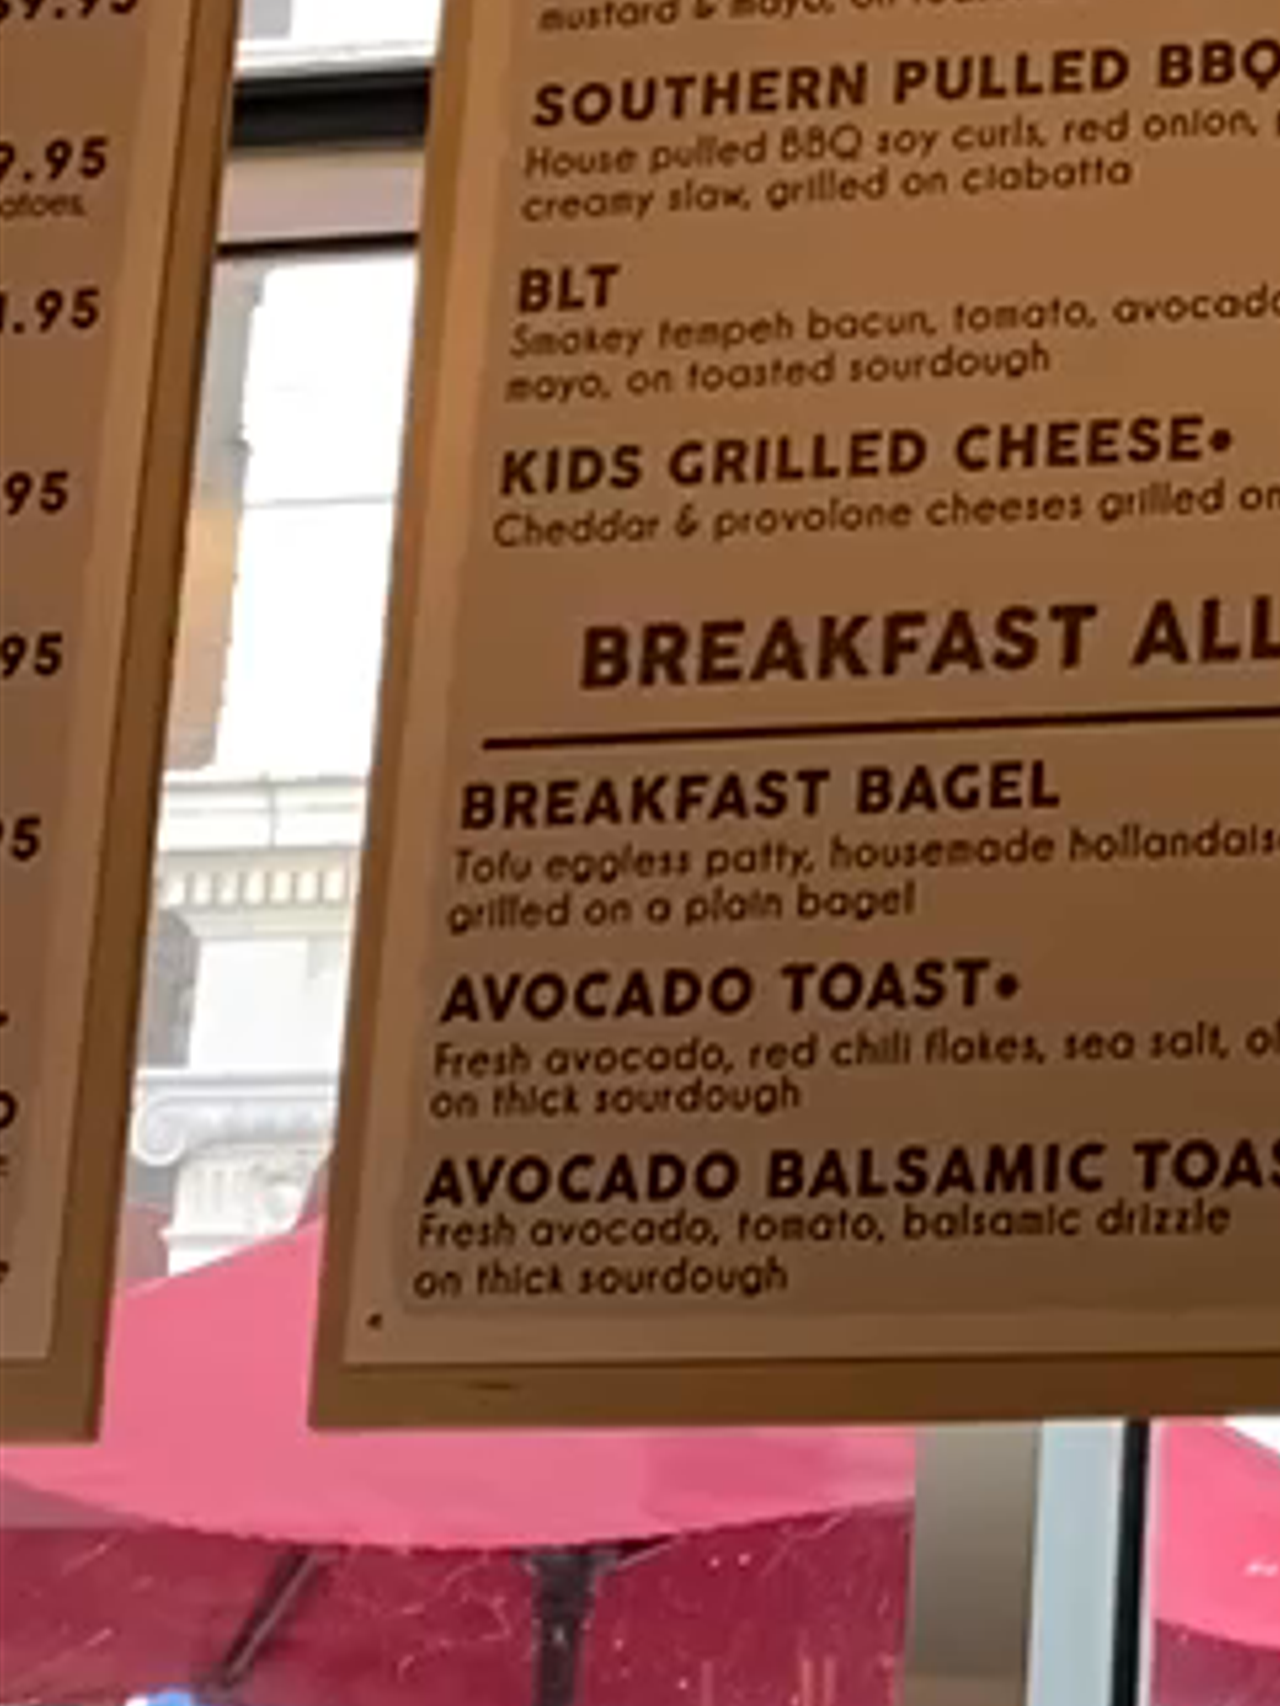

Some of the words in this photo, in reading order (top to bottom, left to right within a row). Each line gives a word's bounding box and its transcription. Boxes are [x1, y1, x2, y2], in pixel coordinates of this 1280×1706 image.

[530, 59, 870, 130] SOUTHERN
[891, 44, 1132, 107] PULLED
[519, 189, 657, 224] creamy
[764, 163, 890, 212] grilled
[898, 169, 950, 199] on
[960, 154, 1135, 197] ciabatta
[0, 287, 99, 334] .95
[514, 261, 623, 317] BLT
[624, 367, 674, 398] on
[686, 349, 838, 394] toasted
[847, 337, 1052, 384] sourdough
[497, 442, 645, 499] KIDS
[665, 426, 929, 490] GRILLED
[491, 507, 662, 549] Cheddar
[672, 501, 702, 540] &
[711, 495, 915, 544] provolone
[924, 489, 1085, 528] cheeses
[1096, 475, 1227, 525] grilled
[577, 601, 1101, 693] BREAKFAST
[458, 765, 833, 833] BREAKFAST
[853, 757, 1063, 817] BAGEL
[444, 888, 574, 939] grilled
[581, 896, 635, 928] on
[643, 894, 674, 927] a
[682, 883, 785, 930] plain
[794, 877, 918, 924] bagel
[436, 962, 758, 1028] AVOCADO
[432, 1039, 534, 1081] Fresh
[746, 1029, 821, 1072] red
[828, 1027, 914, 1070] chili
[1062, 1029, 1137, 1062] sea
[427, 1088, 481, 1121] on
[491, 1078, 583, 1120] thick
[592, 1072, 803, 1119] sourdough
[420, 1147, 743, 1210] AVOCADO
[764, 1139, 1110, 1203] BALSAMIC
[411, 1268, 465, 1301] on
[475, 1256, 567, 1298] thick
[576, 1252, 790, 1300] sourdough
